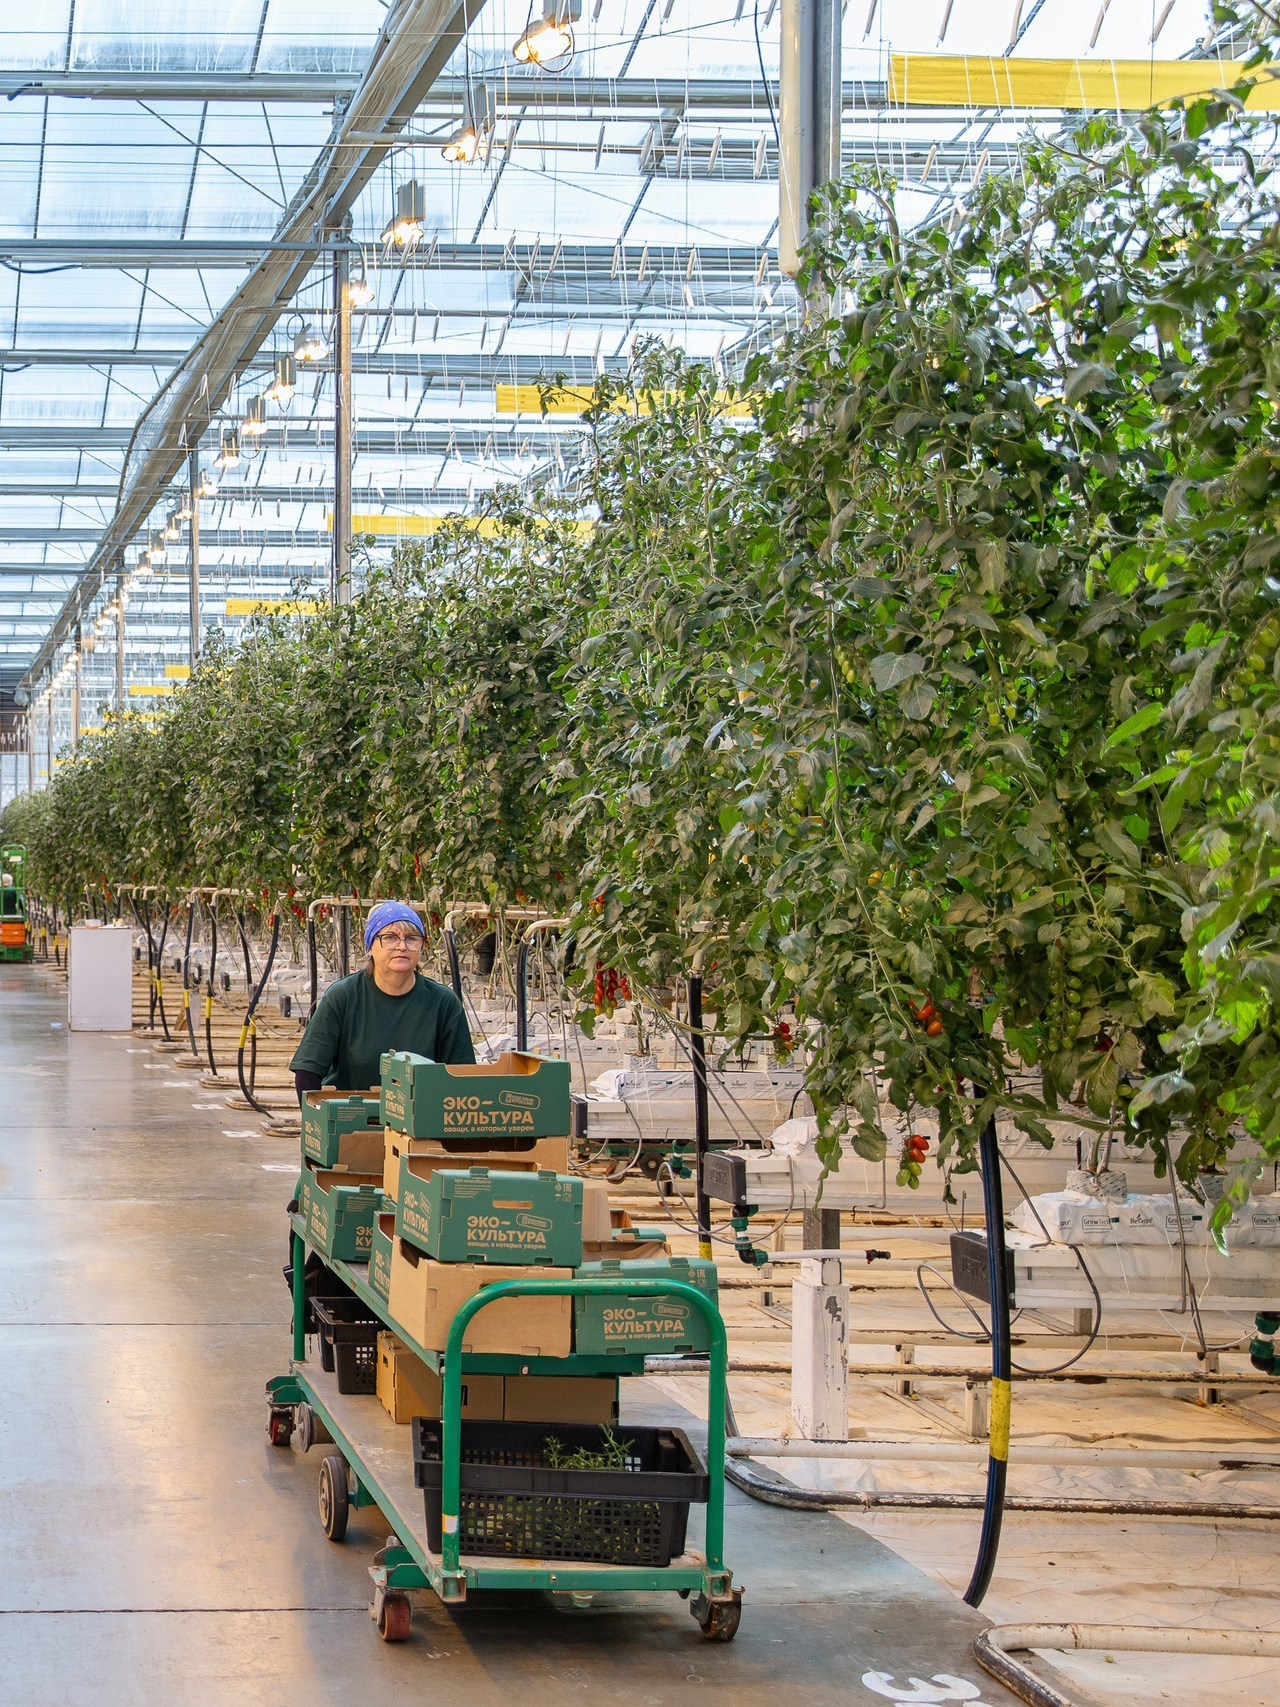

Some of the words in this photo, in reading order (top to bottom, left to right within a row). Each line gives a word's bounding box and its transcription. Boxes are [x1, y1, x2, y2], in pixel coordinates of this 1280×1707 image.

[443, 1110, 534, 1126] КУЛЬТУРА
[508, 1125, 535, 1133] уверен
[467, 1229, 546, 1243] КУЛЬТУРА
[496, 1242, 522, 1250] которых
[603, 1320, 685, 1334] КУЛЬТУРА
